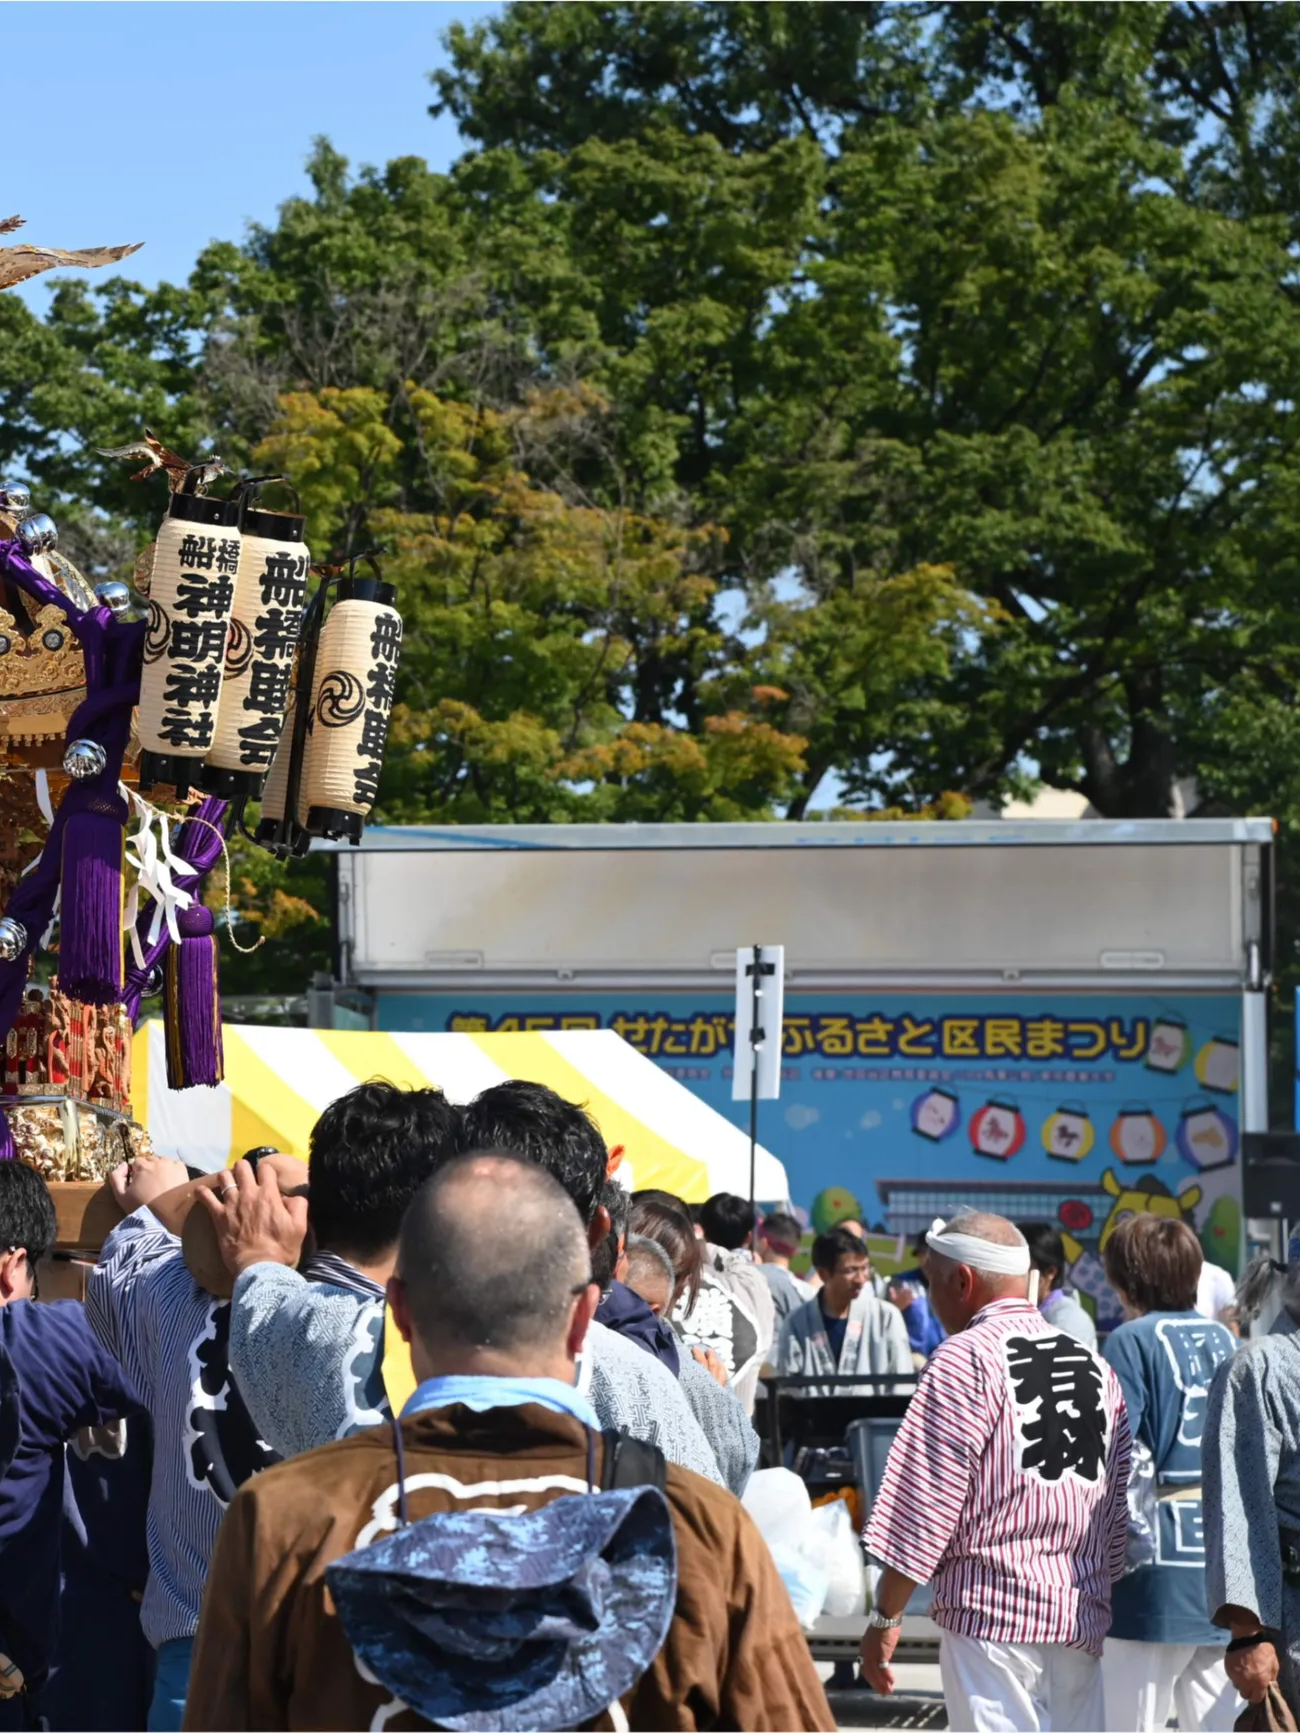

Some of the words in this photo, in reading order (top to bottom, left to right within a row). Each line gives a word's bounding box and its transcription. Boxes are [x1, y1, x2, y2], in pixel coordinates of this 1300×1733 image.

[178, 533, 242, 576] 船橋
[157, 572, 235, 749] 神明神社
[612, 1015, 1146, 1058] せたがふるさと区民まつり
[1006, 1333, 1108, 1482] 若林
